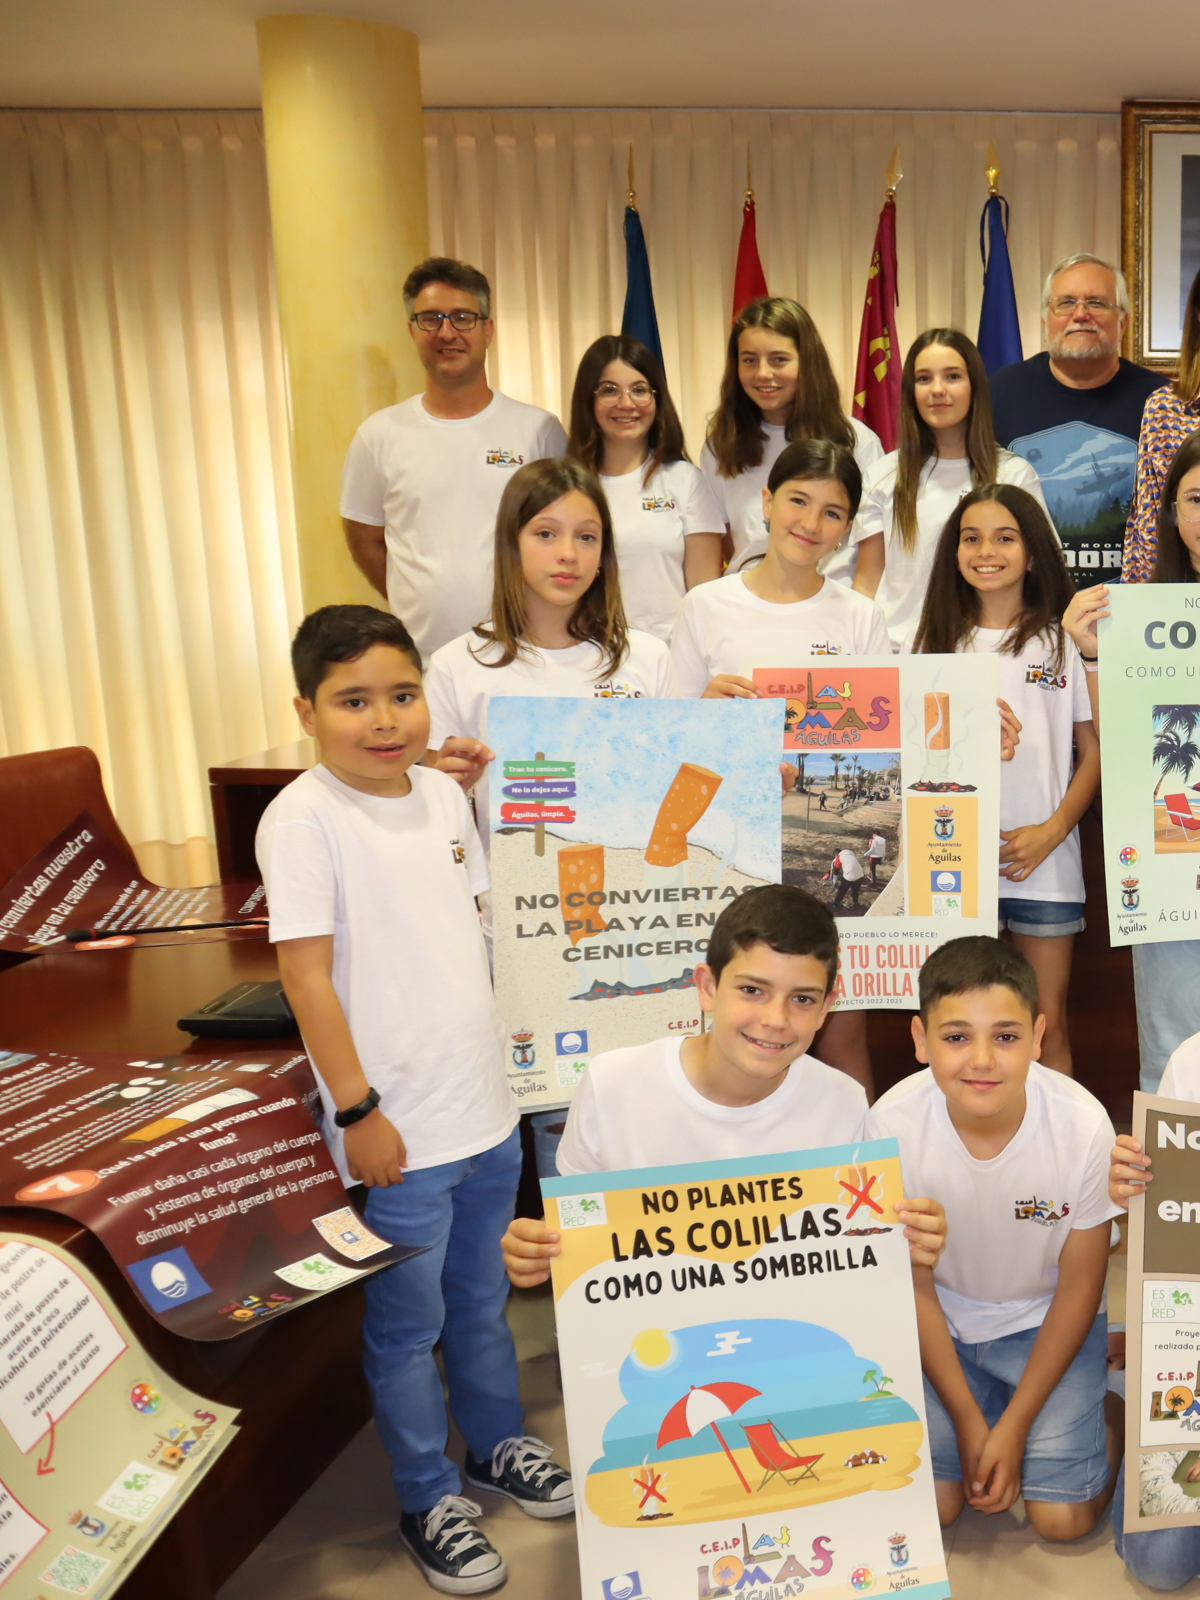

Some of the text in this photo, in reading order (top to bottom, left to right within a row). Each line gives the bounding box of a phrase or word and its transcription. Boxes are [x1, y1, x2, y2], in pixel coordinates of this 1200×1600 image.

[1125, 666, 1176, 678] COMO
[535, 765, 568, 773] cenicero.
[531, 786, 551, 794] dejes
[553, 786, 570, 794] aquí.
[512, 810, 565, 819] Águilas, limpia.
[43, 829, 94, 879] nuestra
[928, 851, 961, 863] Águilas
[64, 859, 106, 904] cenicero
[515, 894, 560, 910] NO
[516, 912, 715, 939] LA PLAYA EN
[1118, 922, 1147, 935] Águilas
[847, 945, 869, 969] TU
[852, 973, 913, 997] ORILLA
[95, 1096, 296, 1180] ¿Qué pasa una persona cuando
[199, 1132, 239, 1152] fuma?
[107, 1132, 321, 1207] Fumar daña casi cada órgano del cuerpo
[155, 1157, 308, 1215] sistema de órganos del cuerpo
[641, 1177, 804, 1215] NO PLANTES
[136, 1169, 338, 1246] disminuye salud general de persona.
[563, 1215, 587, 1228] RED
[612, 1207, 842, 1262] LAS COLILLAS
[585, 1245, 878, 1304] COMO UNA SOMBRILLA
[34, 1287, 61, 1314] postre
[1152, 1289, 1165, 1299] ES
[4, 1300, 24, 1322] miel
[39, 1294, 91, 1349] pulverizador
[1152, 1307, 1176, 1319] RED
[7, 1307, 61, 1361] aceite coco
[1154, 1342, 1194, 1352] realizado
[36, 1331, 95, 1396] gotas aceites
[31, 1344, 100, 1418] esenciales gusto
[888, 1575, 920, 1592] Águilas
